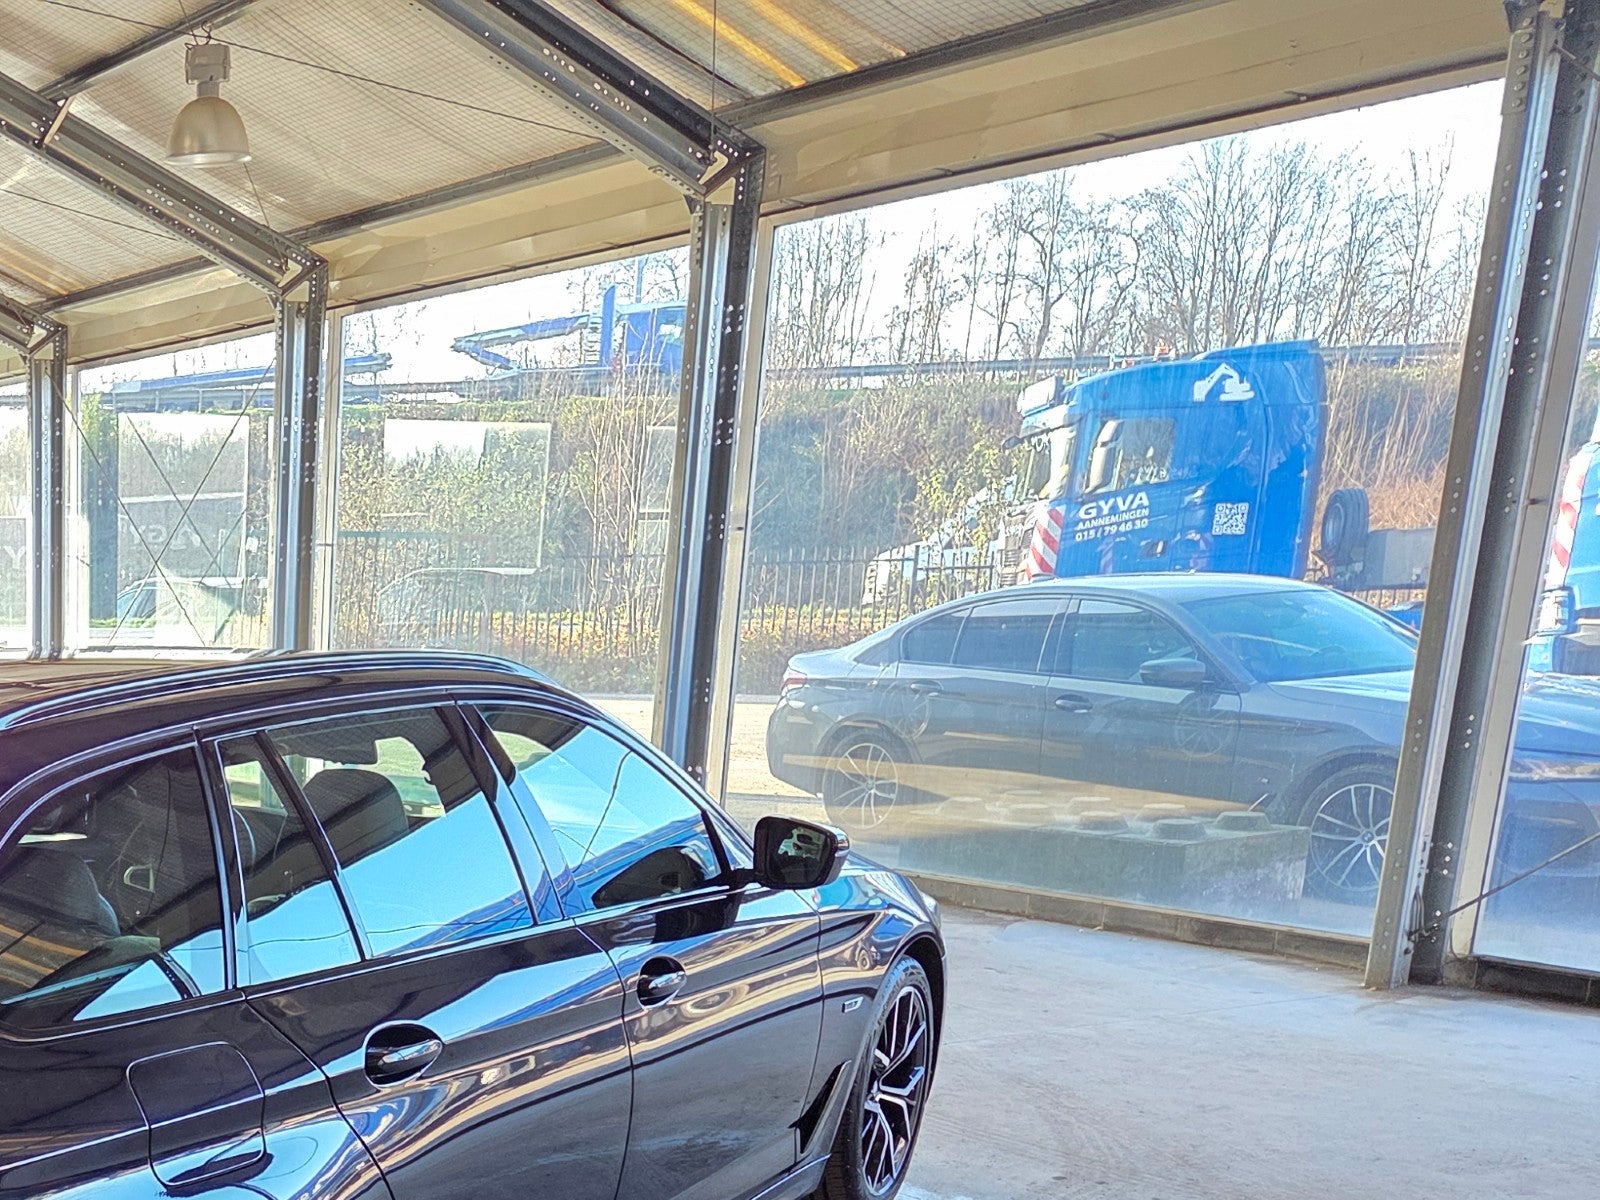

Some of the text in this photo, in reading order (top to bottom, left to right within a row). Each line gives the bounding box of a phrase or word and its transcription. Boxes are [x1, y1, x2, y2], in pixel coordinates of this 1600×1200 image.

[1078, 491, 1150, 519] GYVA
[1074, 508, 1149, 531] AANNEMINGEN
[1075, 530, 1095, 542] 015
[1103, 525, 1117, 537] 79
[1119, 521, 1133, 533] 46
[1134, 518, 1149, 530] 30
